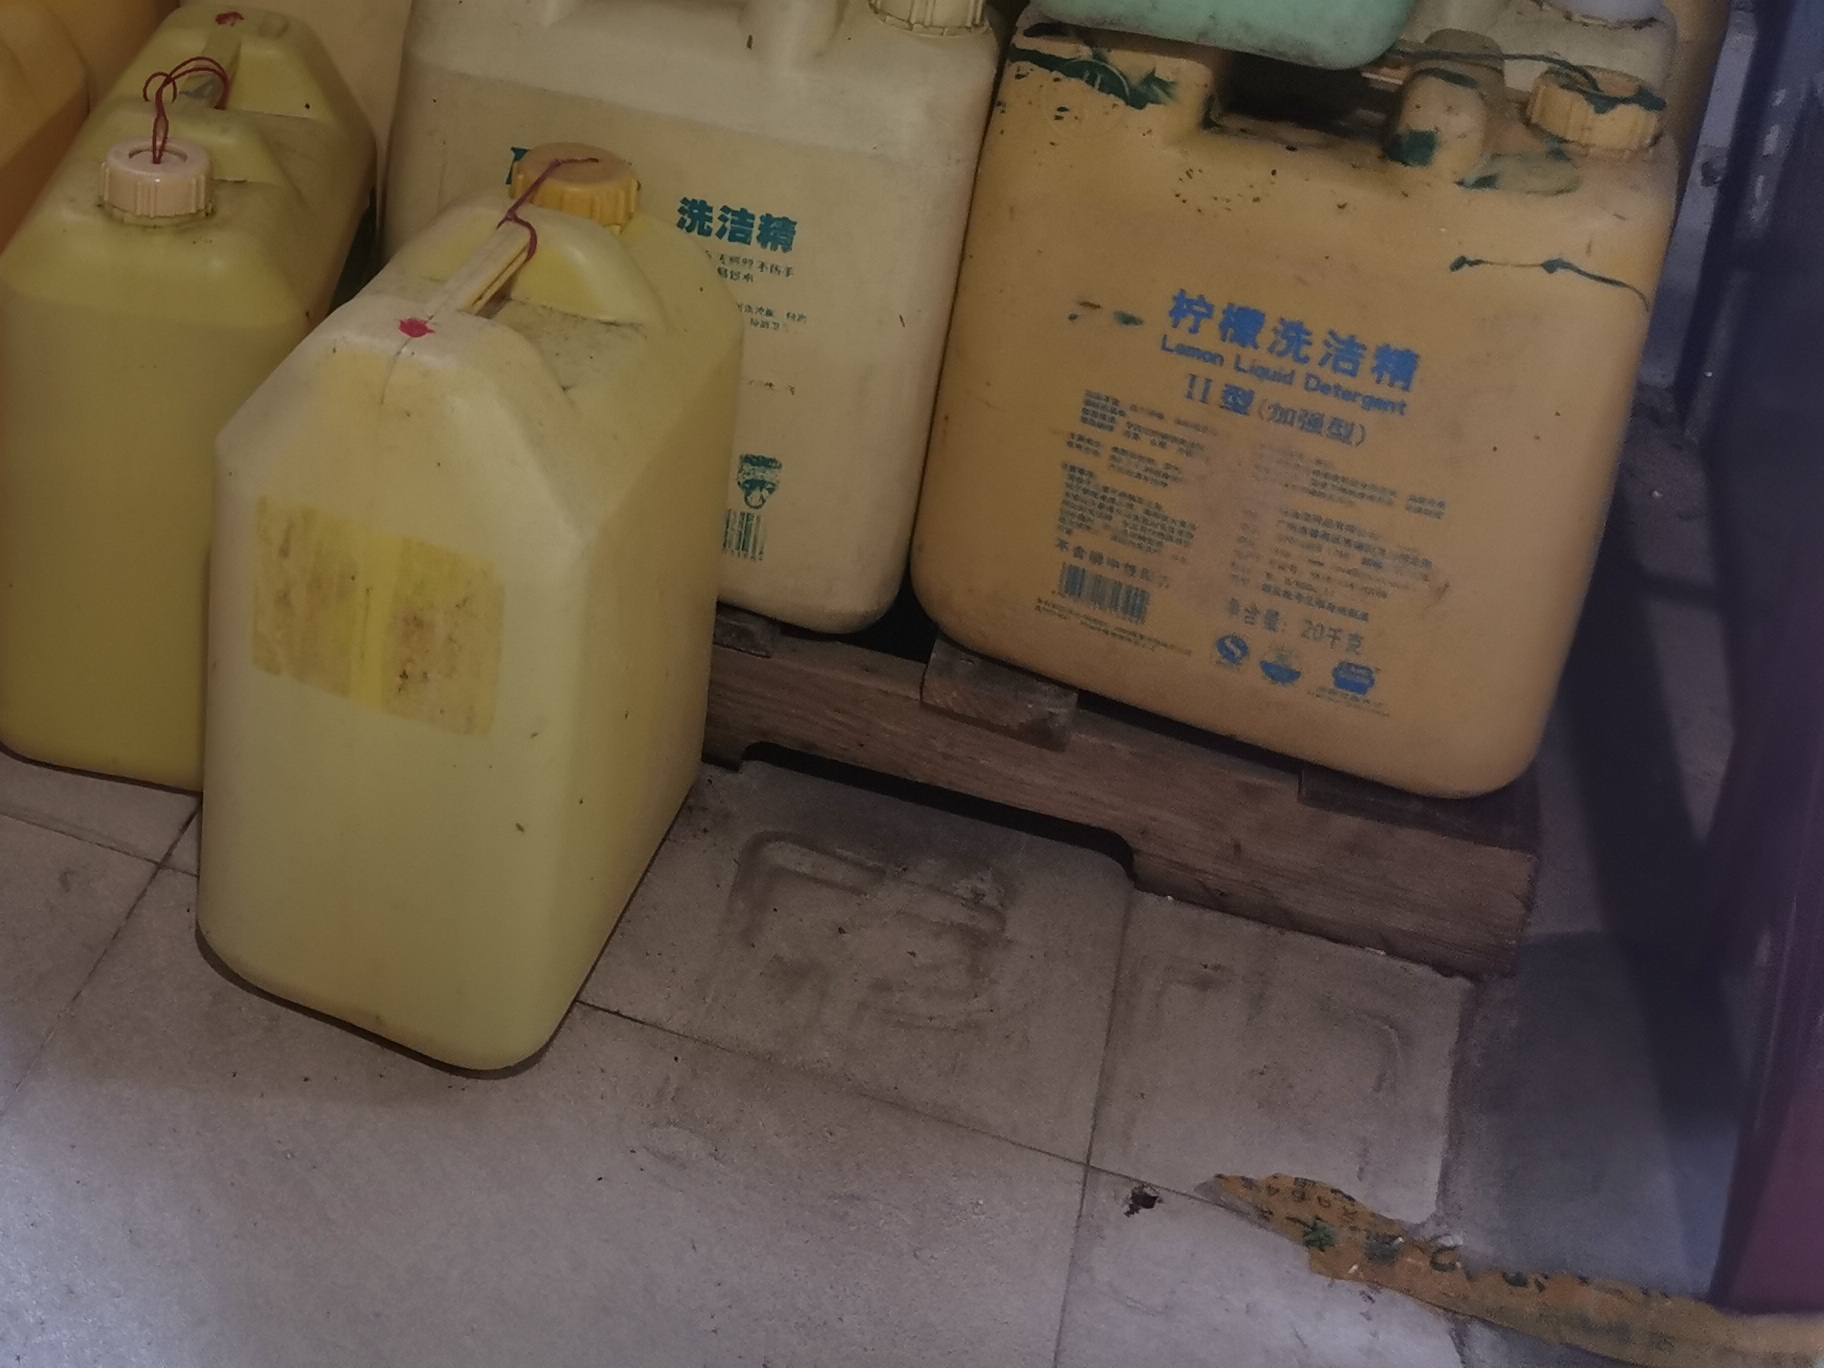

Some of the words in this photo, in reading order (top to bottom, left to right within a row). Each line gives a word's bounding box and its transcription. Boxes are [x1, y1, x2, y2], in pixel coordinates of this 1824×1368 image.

[676, 196, 798, 253] 洗洁精
[1160, 334, 1225, 367] Lemon
[1233, 354, 1296, 386] Liquid
[1304, 373, 1408, 416] Detergent
[1168, 288, 1420, 392] 柠檬洗洁精
